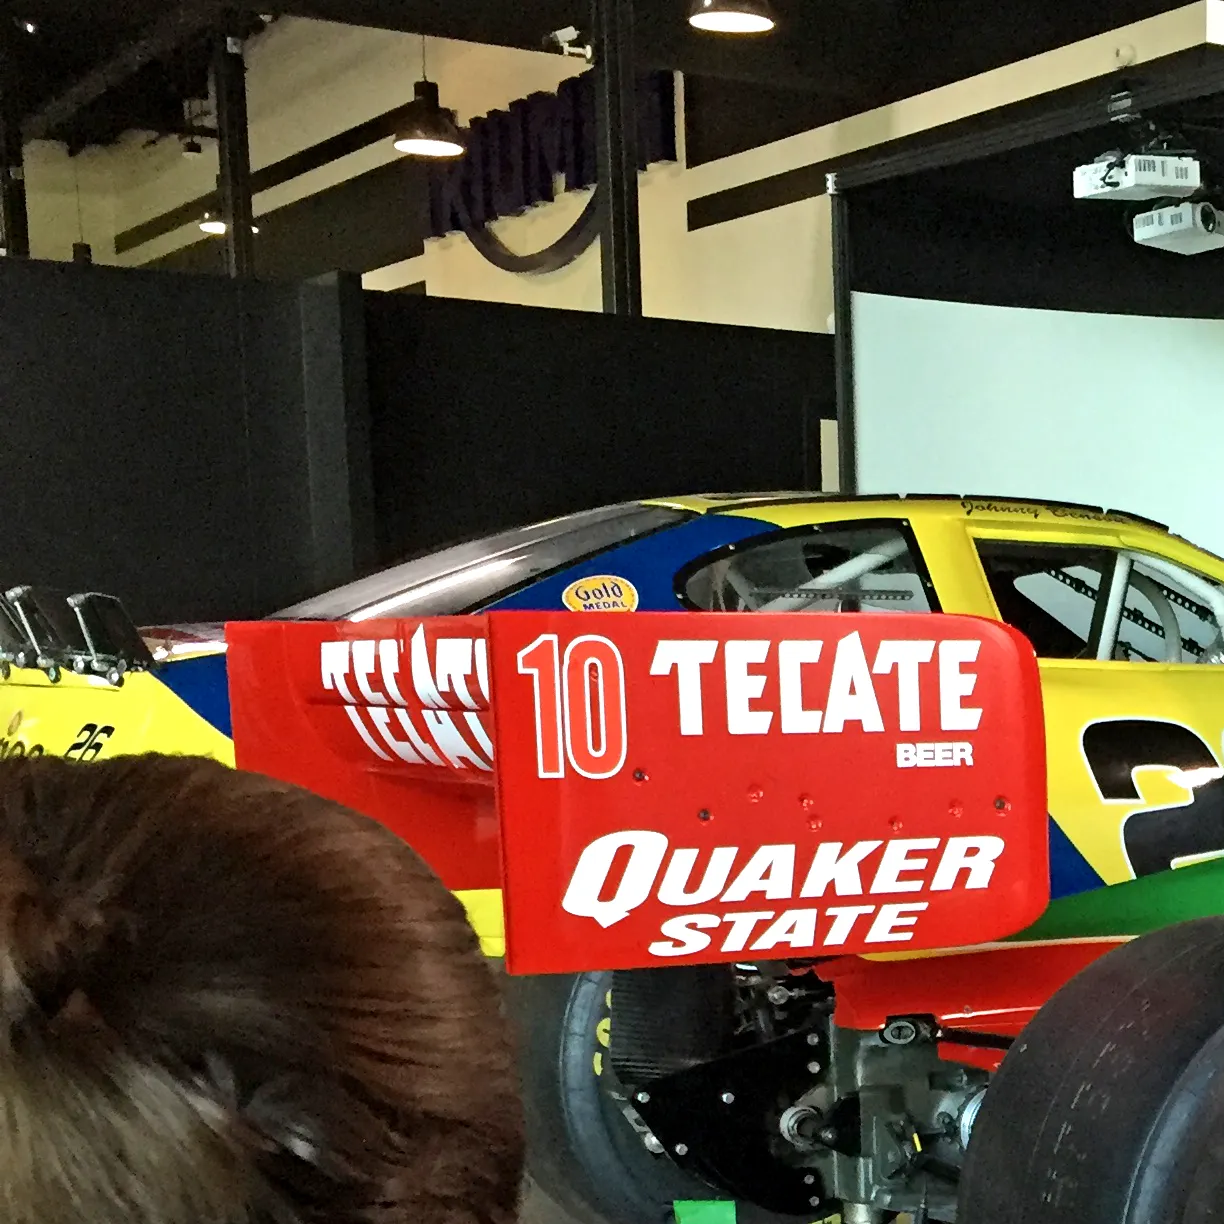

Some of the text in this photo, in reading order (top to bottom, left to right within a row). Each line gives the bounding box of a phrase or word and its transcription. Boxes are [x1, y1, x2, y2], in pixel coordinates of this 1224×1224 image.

[575, 581, 623, 601] Gold
[583, 601, 627, 610] MEDAL
[517, 634, 627, 779] 10
[650, 630, 982, 736] TECATE
[64, 723, 116, 763] 26
[896, 742, 974, 768] BEER
[561, 830, 1004, 928] QUAKER
[649, 902, 928, 956] STATE
